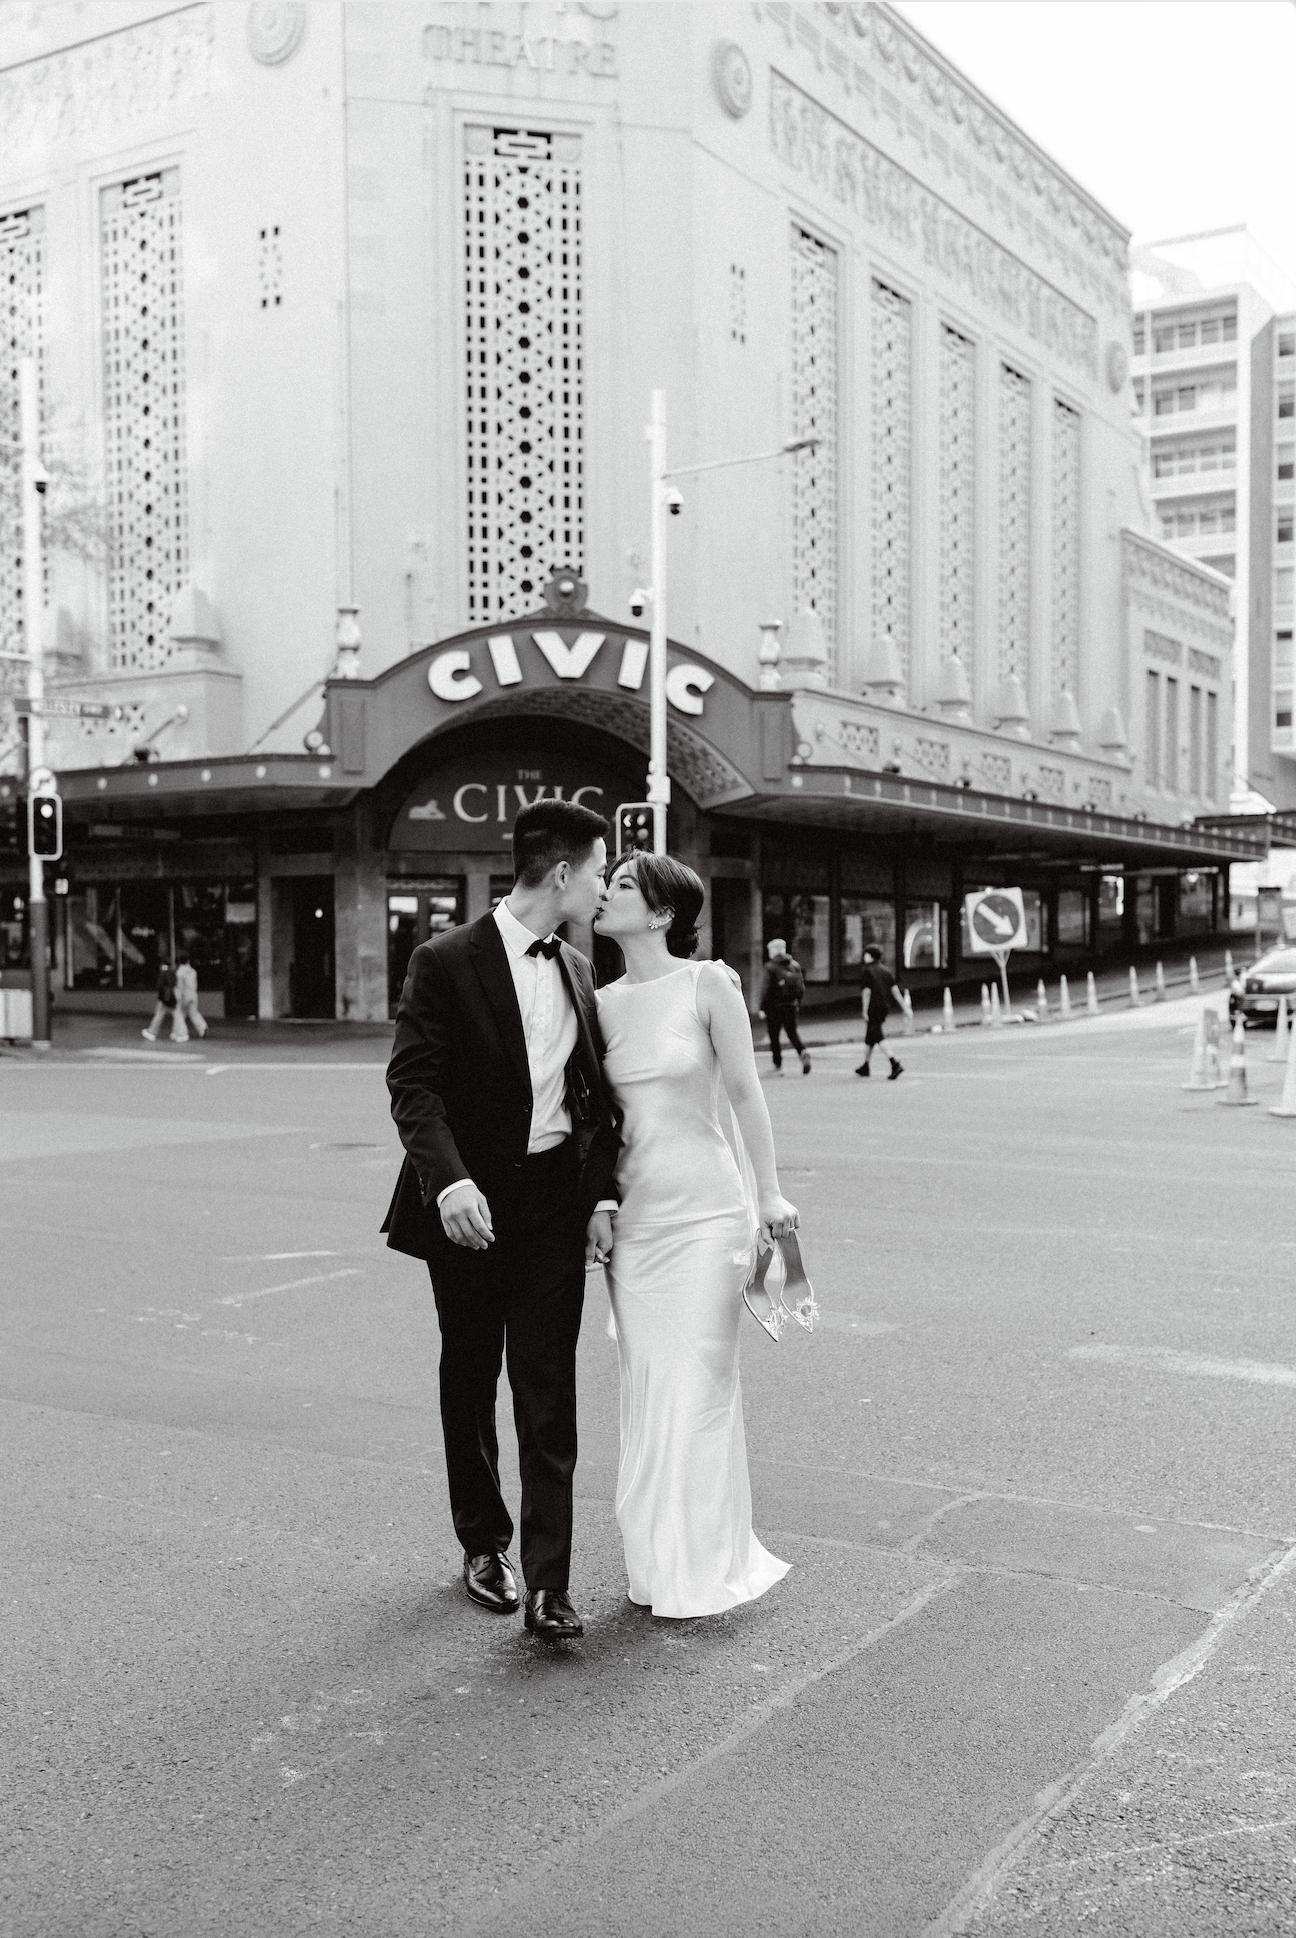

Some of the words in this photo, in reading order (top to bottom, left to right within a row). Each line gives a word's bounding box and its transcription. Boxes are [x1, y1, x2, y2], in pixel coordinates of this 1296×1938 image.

[423, 24, 619, 78] THEATRE
[428, 631, 715, 715] CIVIC
[516, 769, 542, 780] THE
